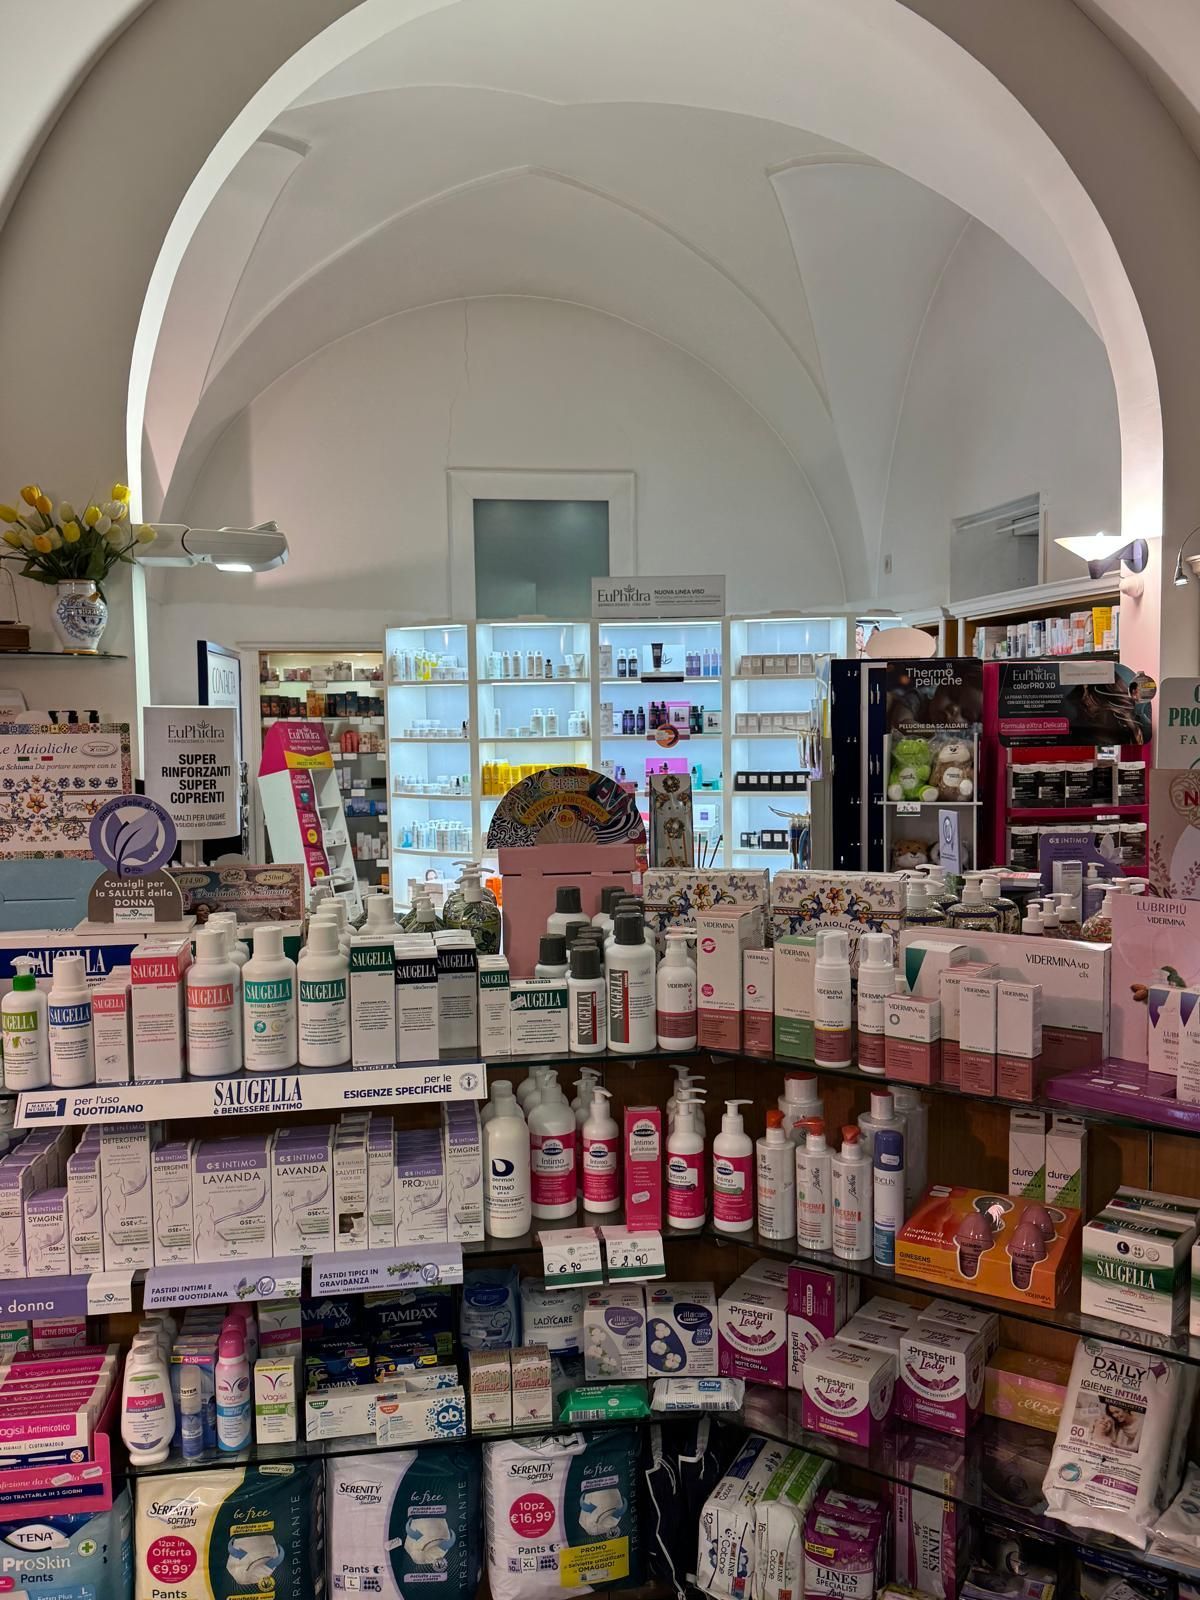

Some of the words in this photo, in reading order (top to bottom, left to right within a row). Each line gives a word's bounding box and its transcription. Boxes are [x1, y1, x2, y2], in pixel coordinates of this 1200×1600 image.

[597, 588, 651, 603] EuPhidra
[654, 588, 674, 596] NUOVA
[905, 666, 953, 678] Thermo
[1012, 668, 1056, 681] EuPhidra
[915, 676, 963, 688] peluche
[1013, 682, 1044, 690] colorPRO
[1045, 682, 1056, 690] XD
[167, 723, 225, 739] EuPhidra
[1000, 721, 1025, 730] Formula
[1026, 721, 1042, 730] eXtra
[1043, 721, 1067, 729] Delicata
[14, 742, 79, 755] Maioliche
[178, 753, 217, 765] SUPER
[5, 763, 34, 771] Schiuma
[72, 763, 96, 771] sempre
[161, 765, 231, 778] RINFORZANTI
[179, 779, 217, 790] SUPER
[170, 791, 225, 804] COPRENTI
[99, 803, 121, 822] amica
[120, 799, 143, 808] delle
[144, 801, 167, 822] donne
[192, 813, 204, 821] PER
[205, 812, 226, 821] UNGHIE
[104, 879, 145, 890] Consigli
[147, 880, 165, 890] per
[108, 889, 145, 898] SALUTE
[147, 888, 173, 898] della
[114, 898, 155, 907] DONNA
[1136, 900, 1187, 915] LUBRIPIÙ
[702, 920, 735, 930] VIDERMINA
[1147, 916, 1186, 927] VIDERMINA
[801, 925, 815, 935] LE
[814, 922, 868, 936] MAIOLICHE
[352, 951, 393, 967] SAUGELLA
[779, 948, 810, 958] VIDERMINA
[437, 953, 475, 969] SAUGELLA
[1025, 952, 1077, 969] VIDERMINA
[133, 963, 176, 979] SAUGELLA
[396, 964, 437, 980] SAUGELLA
[481, 973, 509, 985] SAUGELLA
[187, 988, 231, 1006] SAUGELLA
[246, 983, 290, 1001] SAUGELLA
[301, 982, 344, 1000] SAUGELLA
[610, 969, 624, 1021] SAUGELLA
[93, 999, 125, 1010] SAUGELLA
[50, 1007, 90, 1023] SAUGELLA
[578, 992, 592, 1037] SAUGELLA
[424, 1074, 441, 1083] per
[443, 1073, 452, 1082] le
[213, 1076, 303, 1107] SAUGELLA
[343, 1087, 393, 1099] ESIGENZE
[395, 1083, 453, 1096] SPECIFICHE
[74, 1097, 93, 1106] per
[94, 1094, 120, 1105] l'uso
[73, 1103, 144, 1117] QUOTIDIANO
[213, 1107, 220, 1115] è
[221, 1104, 270, 1114] BENESSERE
[272, 1102, 303, 1111] INTIMO
[102, 1135, 147, 1145] DETERGENTE
[448, 1145, 480, 1154] SYMGINE
[293, 1153, 324, 1161] INTIMO
[541, 1157, 565, 1165] Intimo
[154, 1163, 189, 1172] DETERGENTE
[222, 1159, 257, 1168] INTIMO
[276, 1164, 327, 1177] LAVANDA
[1012, 1167, 1038, 1177] durex
[1047, 1170, 1074, 1181] durex
[202, 1171, 261, 1184] LAVANDA
[1047, 1184, 1077, 1193] NATURALS
[28, 1214, 63, 1223] SYMGINE
[899, 1252, 931, 1263] GINESENS
[319, 1270, 347, 1280] FASTIDI
[348, 1268, 369, 1278] TIPICI
[369, 1268, 379, 1276] IN
[1096, 1259, 1156, 1289] SAUGELLA
[319, 1276, 370, 1288] GRAVIDANZA
[151, 1286, 180, 1295] FASTIDI
[181, 1284, 206, 1293] INTIMI
[151, 1295, 177, 1303] IGIENE
[179, 1291, 229, 1301] QUOTIDIANA
[8, 1300, 54, 1313] donna
[379, 1307, 438, 1325] TAMPAX
[728, 1305, 773, 1321] Presteril
[533, 1315, 573, 1326] LADYCARE
[738, 1315, 763, 1330] Lady
[41, 1327, 57, 1337] ACTIVE
[791, 1331, 800, 1374] Presteril
[908, 1346, 956, 1366] Presteril
[919, 1357, 945, 1374] Lady
[1092, 1356, 1148, 1379] DAILY
[699, 1380, 721, 1388] Chilly
[815, 1374, 855, 1390] Presteril
[1090, 1368, 1143, 1389] COMFORT
[825, 1383, 846, 1397] Lady
[1080, 1379, 1114, 1395] IGIENE
[1115, 1389, 1149, 1404] INTIMA
[261, 1394, 288, 1403] Vagisil
[27, 1423, 71, 1435] Antimicotico
[1070, 1426, 1085, 1438] 60
[510, 1462, 553, 1477] SERENITY
[583, 1465, 593, 1476] be
[594, 1462, 615, 1478] free
[338, 1482, 382, 1494] SERENITY
[1102, 1477, 1117, 1490] pH
[13, 1491, 47, 1500] TRATTARLA
[61, 1488, 83, 1496] GIORNI
[410, 1491, 420, 1501] be
[421, 1489, 444, 1505] free
[519, 1501, 545, 1512] 10pz
[234, 1508, 243, 1519] be
[244, 1506, 272, 1523] free
[17, 1532, 53, 1543] TENA
[458, 1480, 468, 1590] TRASPIRANTE
[158, 1540, 176, 1548] 12pz
[580, 1544, 607, 1554] PROMO
[152, 1547, 192, 1558] Offerta
[518, 1545, 546, 1556] Pants
[718, 1539, 731, 1575] Cotone
[2, 1555, 71, 1573] ProSkin
[342, 1564, 370, 1574] Pants
[522, 1560, 535, 1568] XL
[578, 1561, 615, 1574] OMAGGIO!
[768, 1548, 779, 1580] Cotone
[20, 1573, 54, 1585] Pants
[816, 1567, 858, 1586] LINES
[815, 1577, 858, 1593] SPECIALIST
[152, 1589, 187, 1600] Pants
